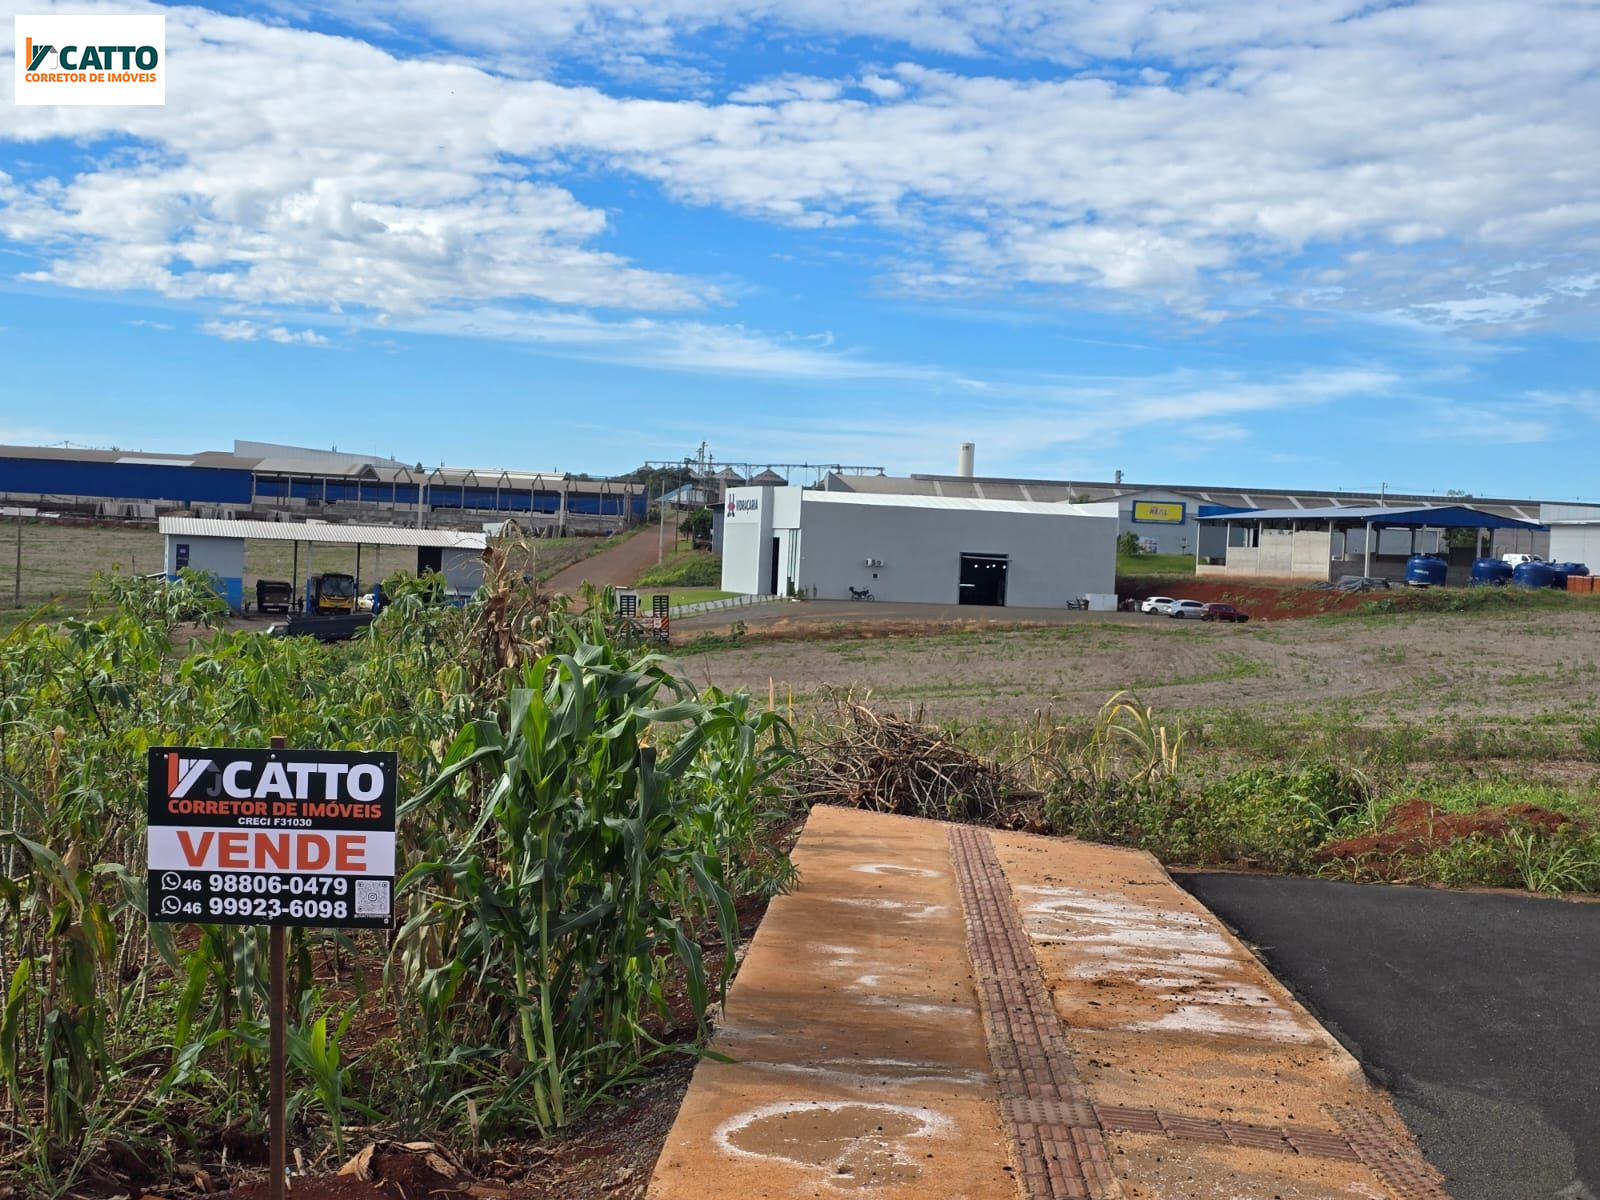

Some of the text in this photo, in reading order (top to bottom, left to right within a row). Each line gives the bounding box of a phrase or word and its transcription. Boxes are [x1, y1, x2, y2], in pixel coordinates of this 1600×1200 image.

[168, 800, 382, 819] CORRETOR DE IMÓVEIS
[238, 816, 312, 827] CRECI F31030
[176, 831, 367, 872] VENDE
[182, 874, 348, 896] 46 98806-0479
[182, 897, 348, 919] 46 99923-6098
